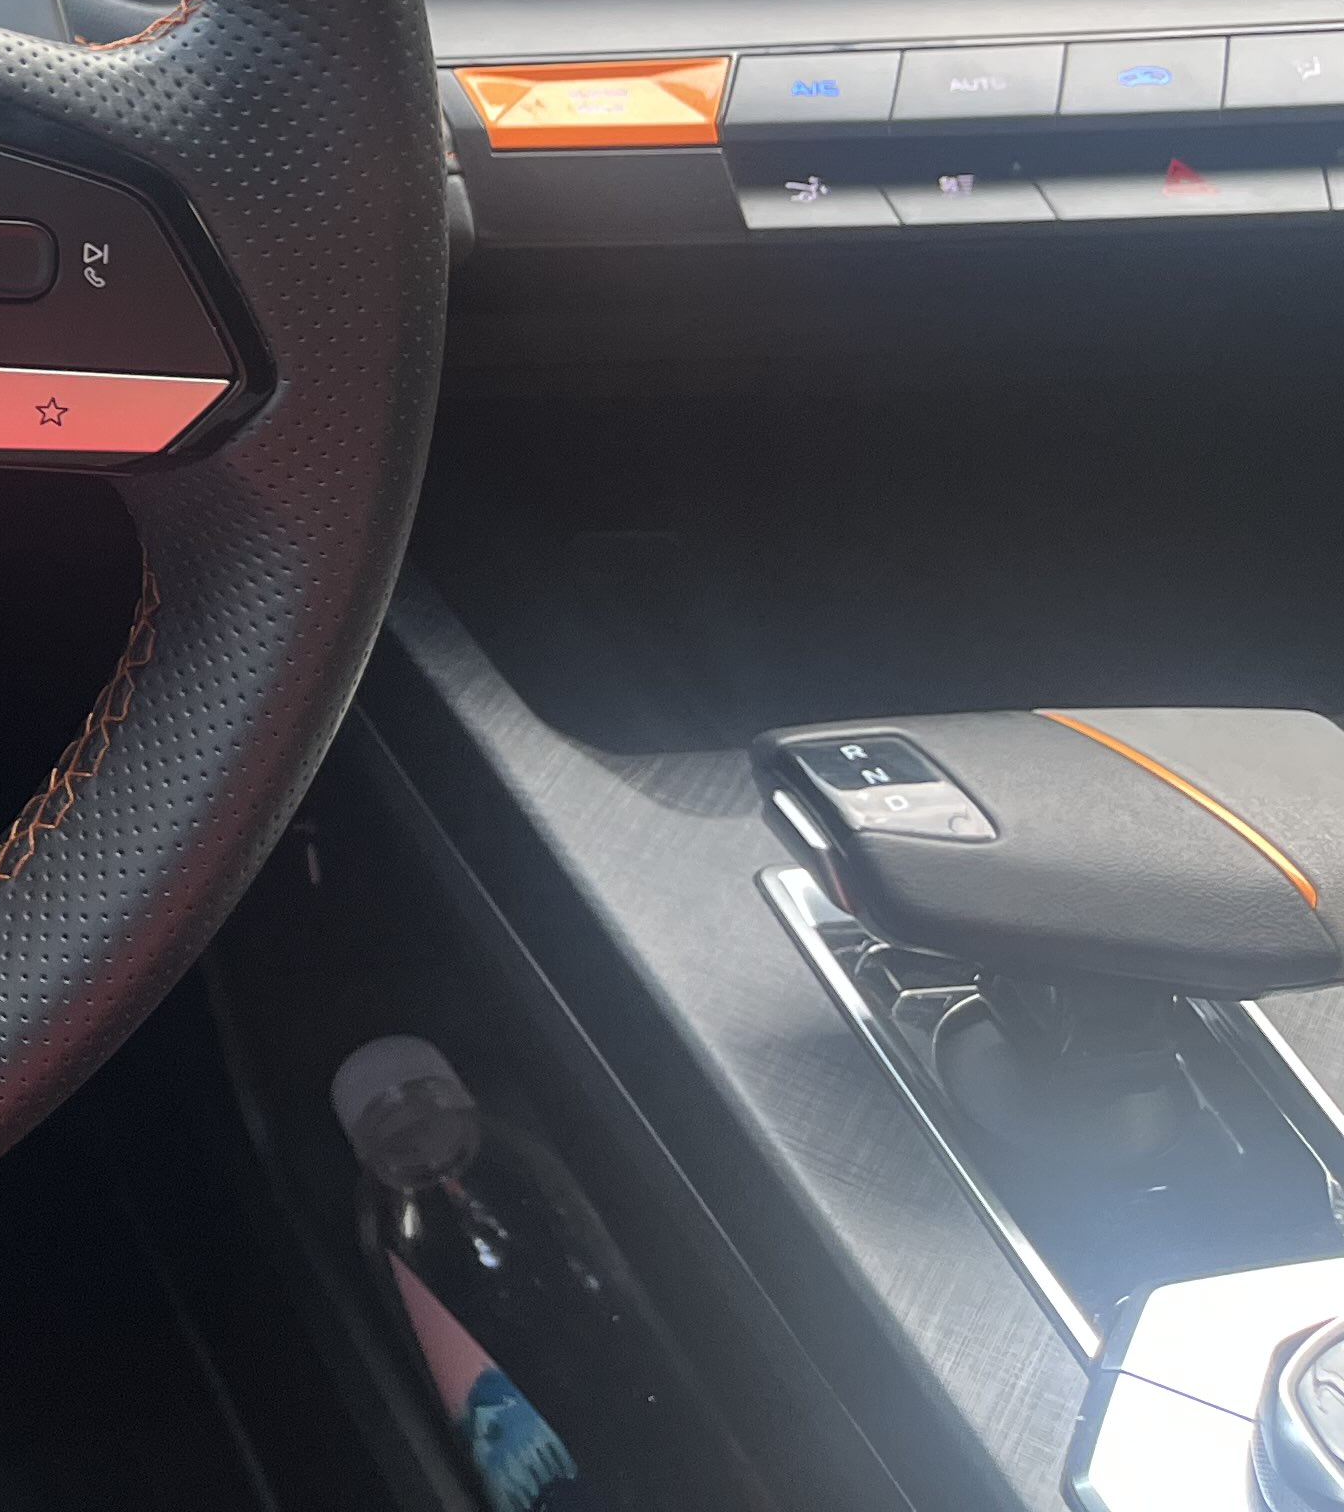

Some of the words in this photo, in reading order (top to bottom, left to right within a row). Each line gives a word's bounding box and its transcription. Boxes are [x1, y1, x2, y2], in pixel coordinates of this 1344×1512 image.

[840, 744, 869, 760] R
[861, 767, 890, 784] N
[884, 795, 908, 811] D
